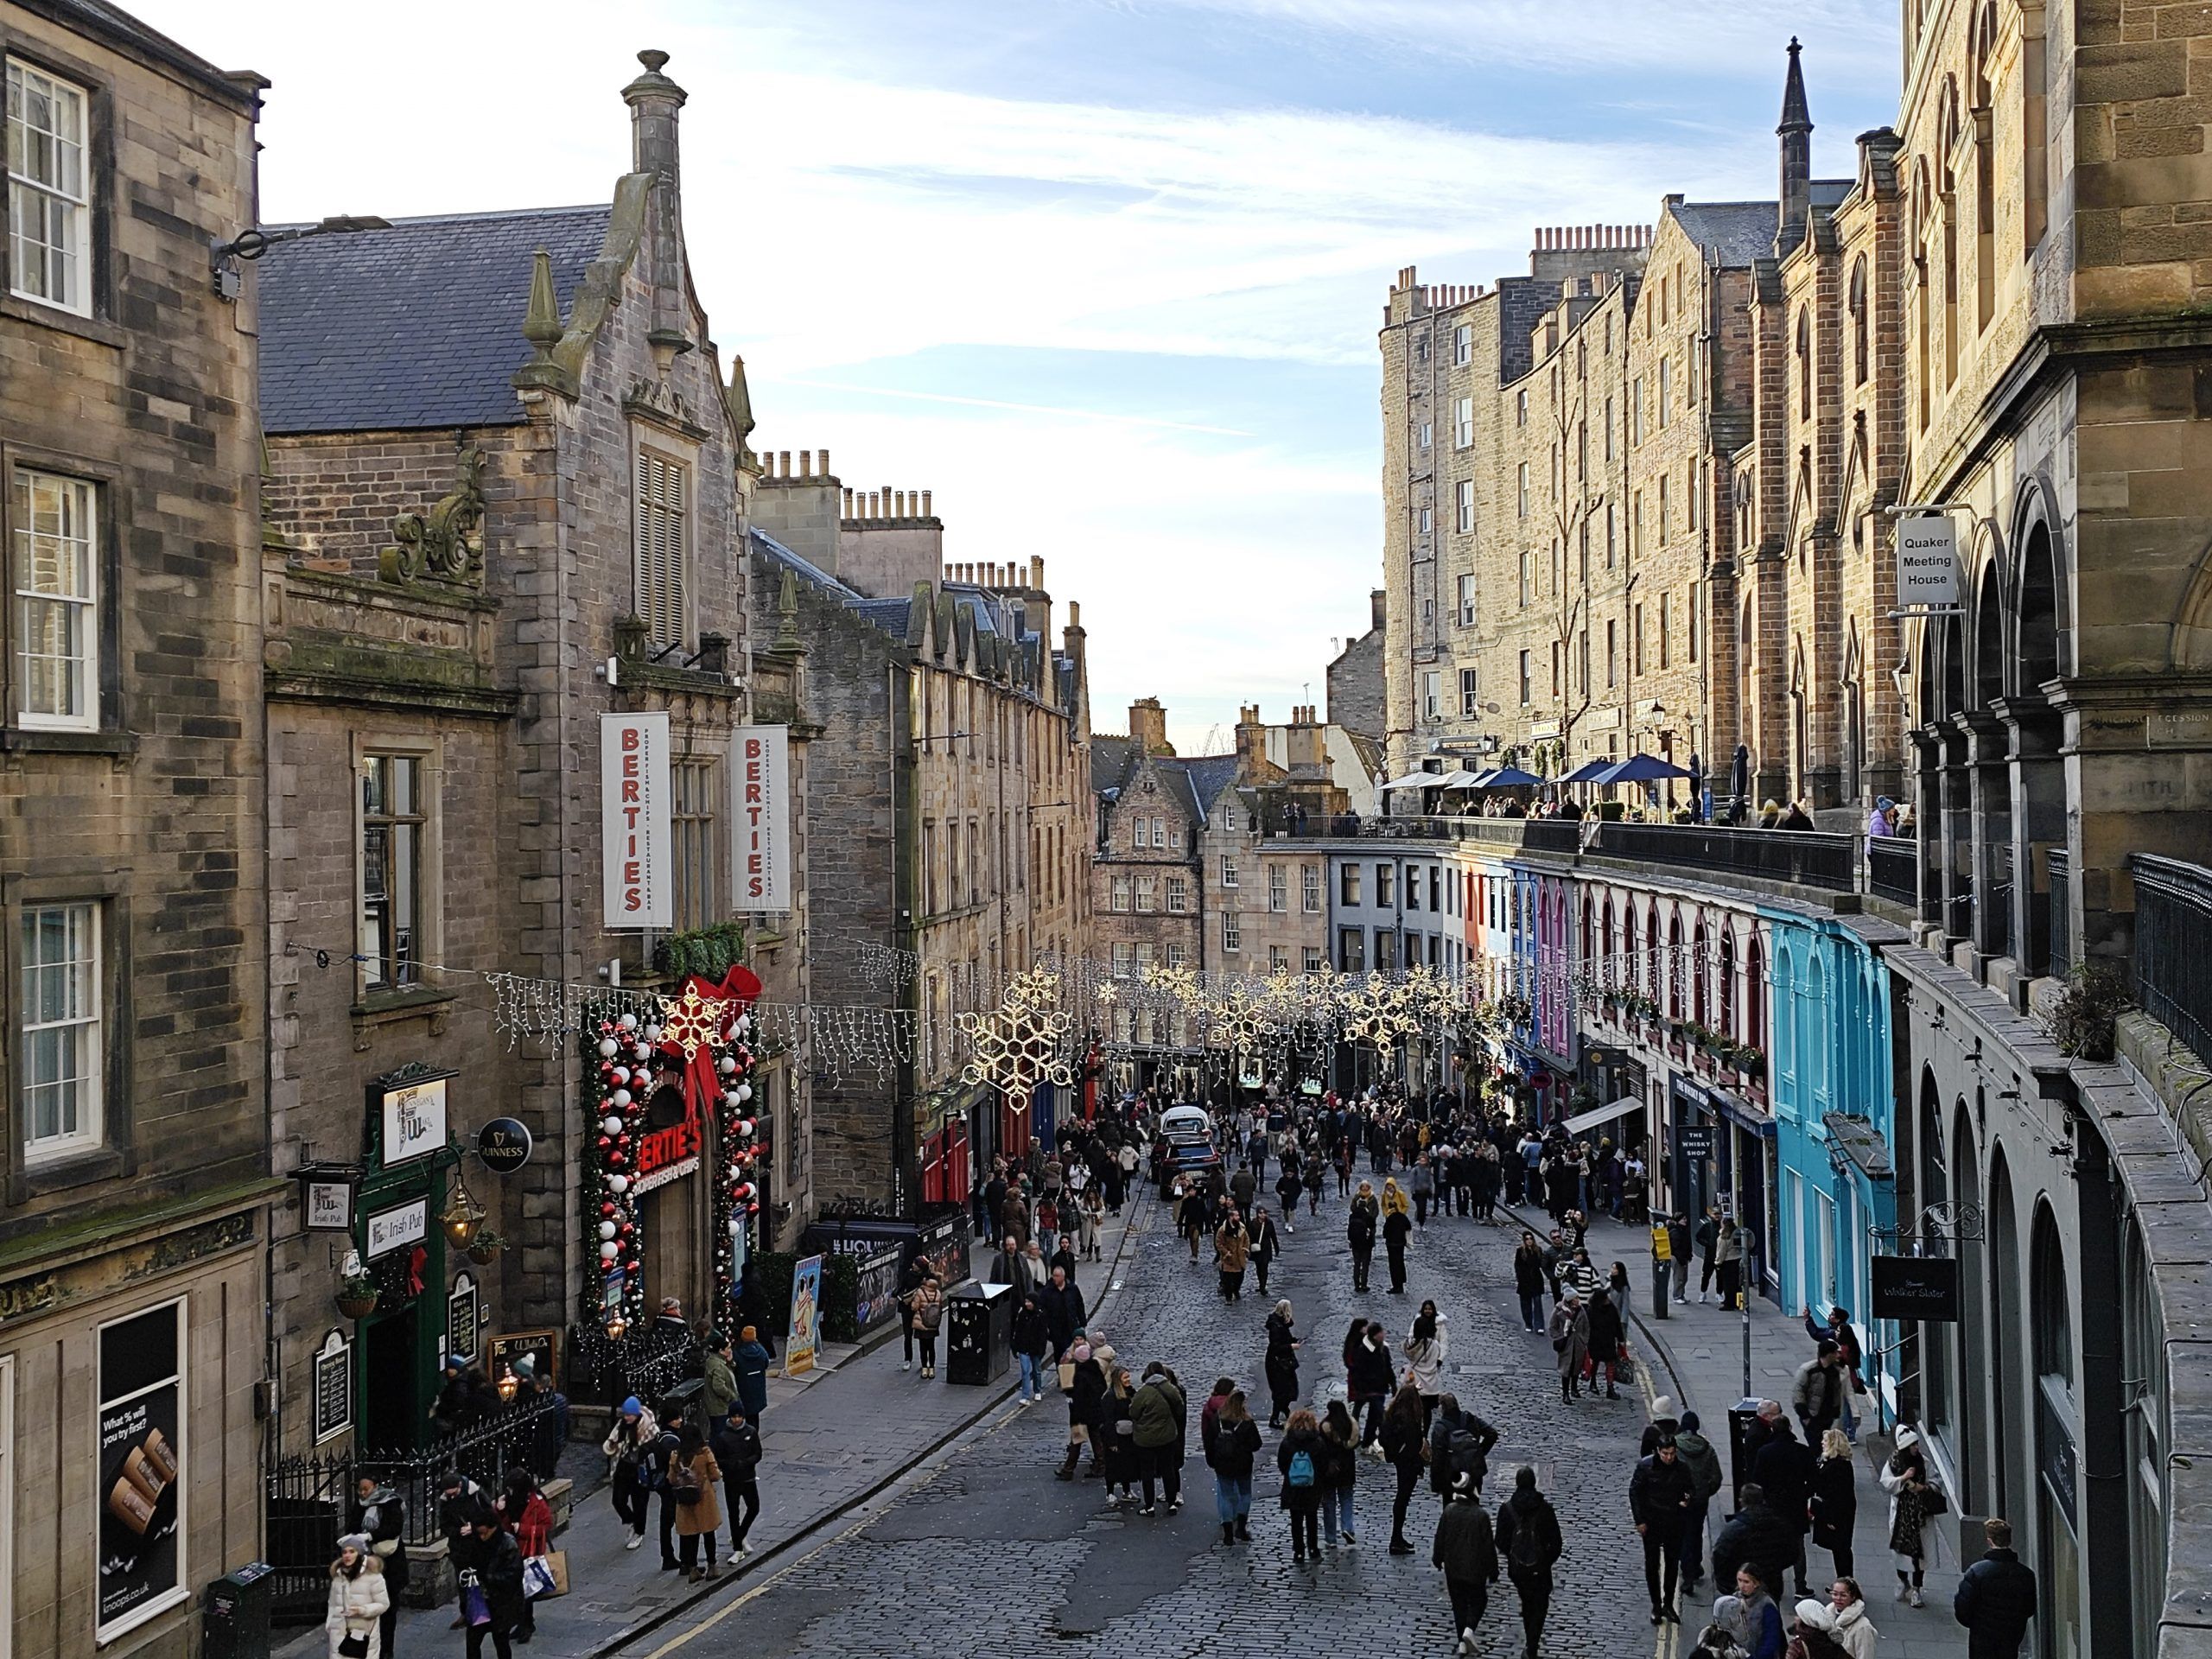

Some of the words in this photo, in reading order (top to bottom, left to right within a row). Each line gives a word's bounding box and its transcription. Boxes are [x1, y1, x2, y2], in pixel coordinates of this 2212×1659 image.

[1904, 537, 1949, 549] Quaker
[1904, 556, 1951, 567] Meeting
[1908, 575, 1947, 585] House
[621, 728, 641, 912] BERTIES
[745, 739, 763, 898] BERTIES
[480, 1145, 524, 1157] GUINNESS
[632, 1174, 658, 1197] ROPER
[104, 1417, 124, 1432] What
[124, 1411, 132, 1423] %
[133, 1404, 145, 1419] will
[104, 1433, 118, 1449] you
[118, 1428, 129, 1440] try
[129, 1418, 147, 1434] first?
[103, 1580, 149, 1615] knoops.co.uk
